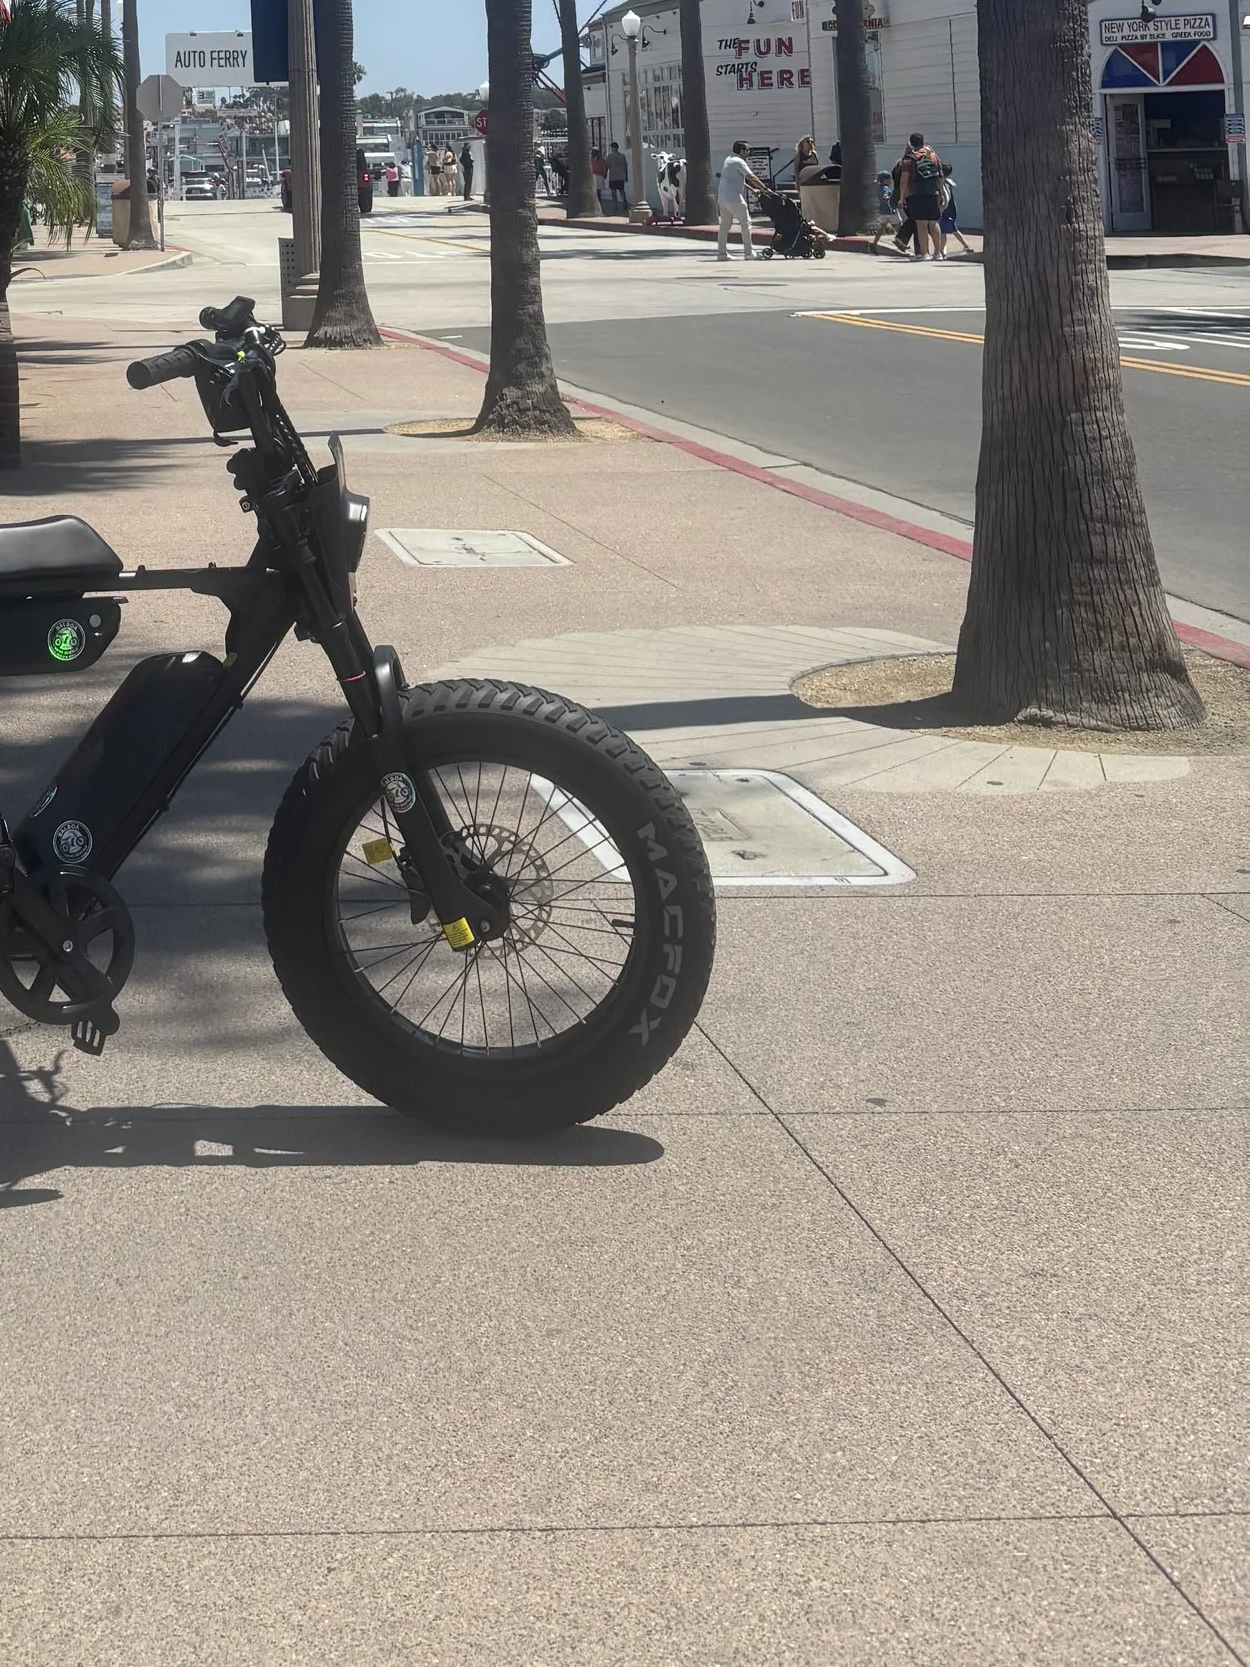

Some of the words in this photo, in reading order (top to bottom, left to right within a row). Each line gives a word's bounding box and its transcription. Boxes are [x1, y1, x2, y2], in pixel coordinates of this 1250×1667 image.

[1104, 22, 1124, 34] NEW
[1127, 20, 1150, 33] YORK
[1153, 18, 1181, 31] STYLE
[1183, 17, 1211, 29] PIZZA
[718, 37, 739, 50] THE
[735, 36, 794, 59] FUN
[175, 50, 206, 68] AUTO
[210, 49, 248, 68] FERRY
[716, 61, 758, 76] STARTS
[736, 68, 812, 91] HERE
[476, 117, 488, 128] ST
[628, 822, 684, 1047] MACFOX
